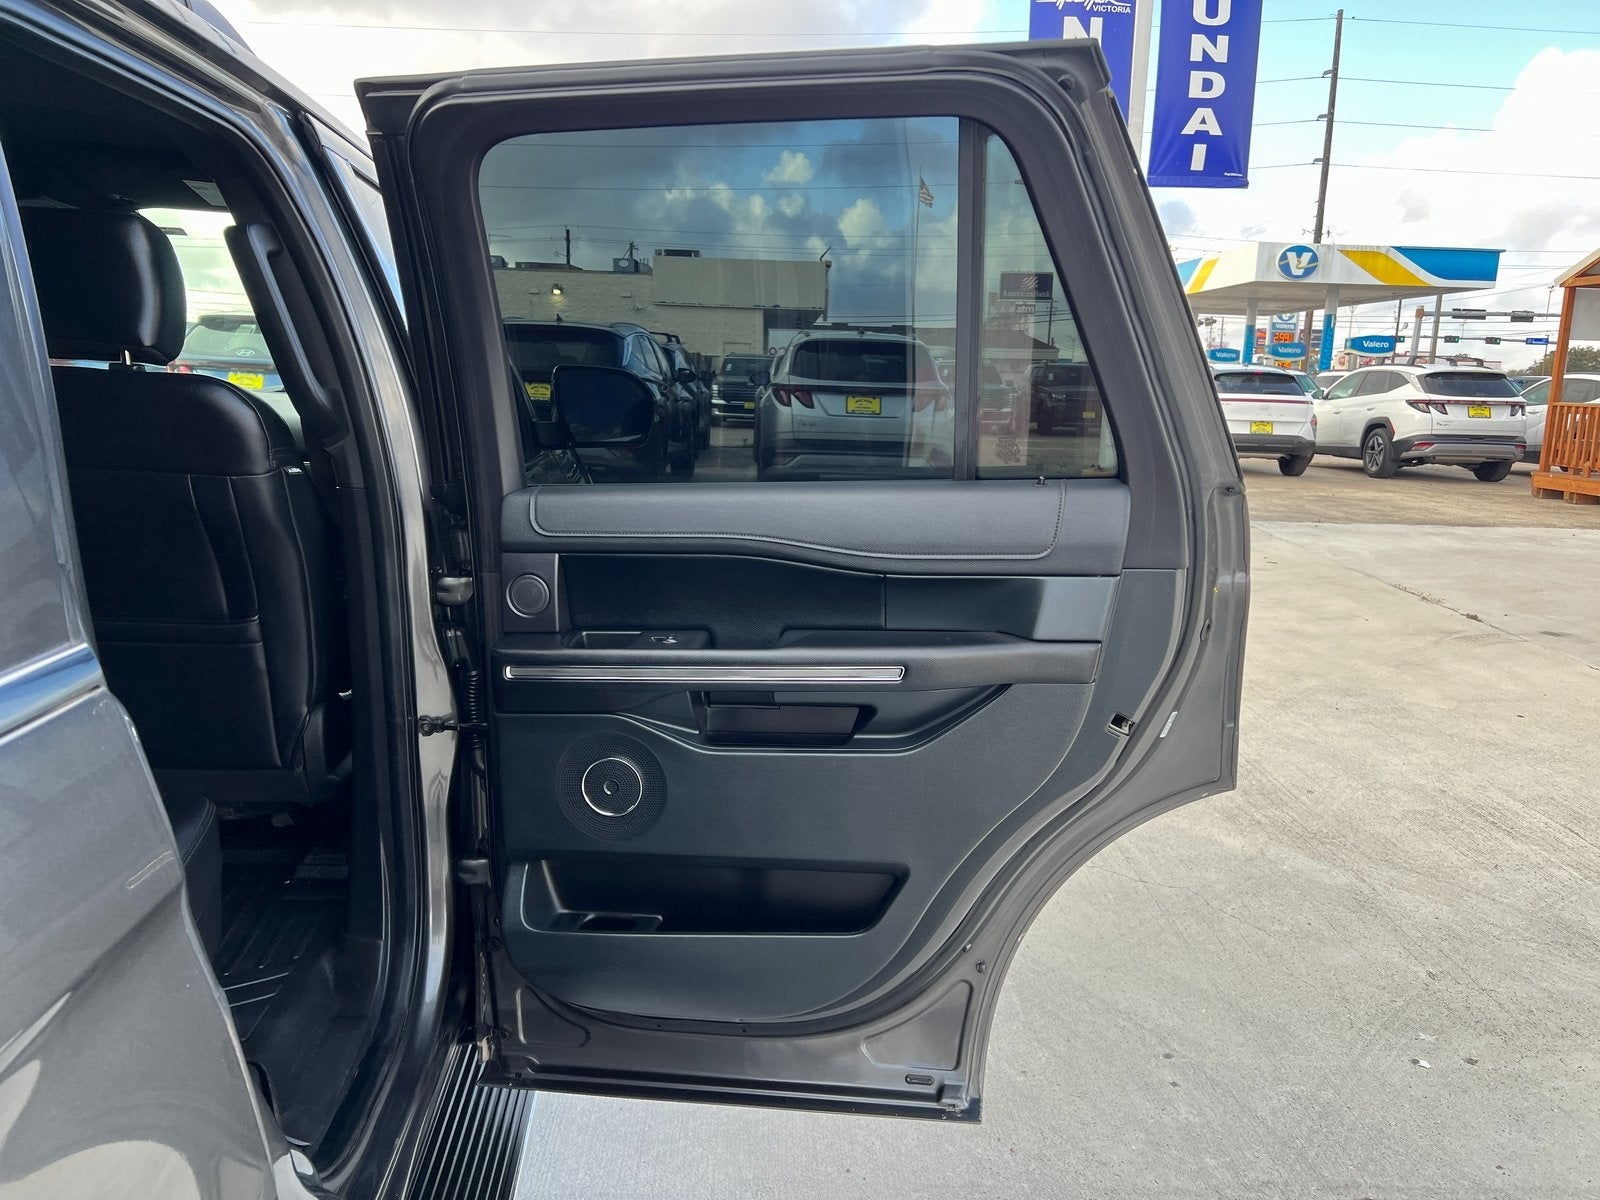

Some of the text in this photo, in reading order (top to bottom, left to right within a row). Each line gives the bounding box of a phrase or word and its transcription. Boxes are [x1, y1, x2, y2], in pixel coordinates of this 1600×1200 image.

[1092, 4, 1132, 14] VICTORIA
[1276, 322, 1296, 330] Valero
[1362, 340, 1390, 348] Valero
